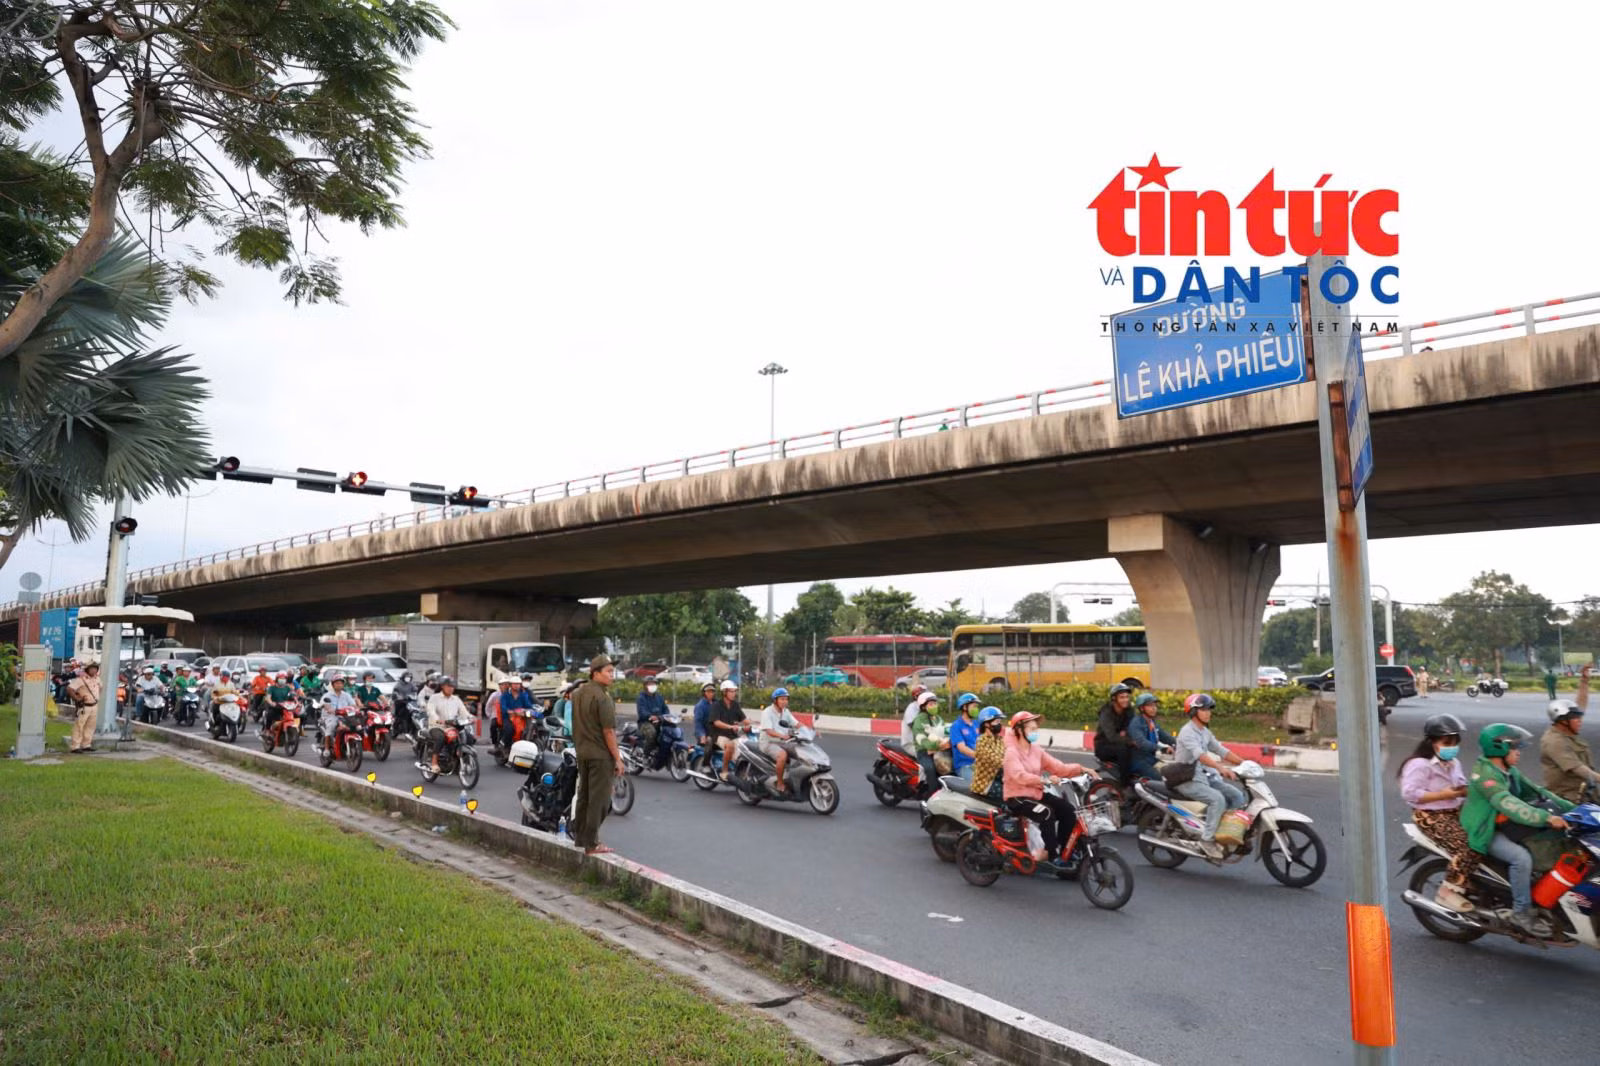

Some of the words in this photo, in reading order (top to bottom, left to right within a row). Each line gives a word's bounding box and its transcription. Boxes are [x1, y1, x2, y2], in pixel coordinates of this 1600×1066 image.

[1123, 360, 1153, 403] LÊ
[1158, 342, 1211, 395] KHẢ
[1216, 331, 1295, 382] PHIÊU
